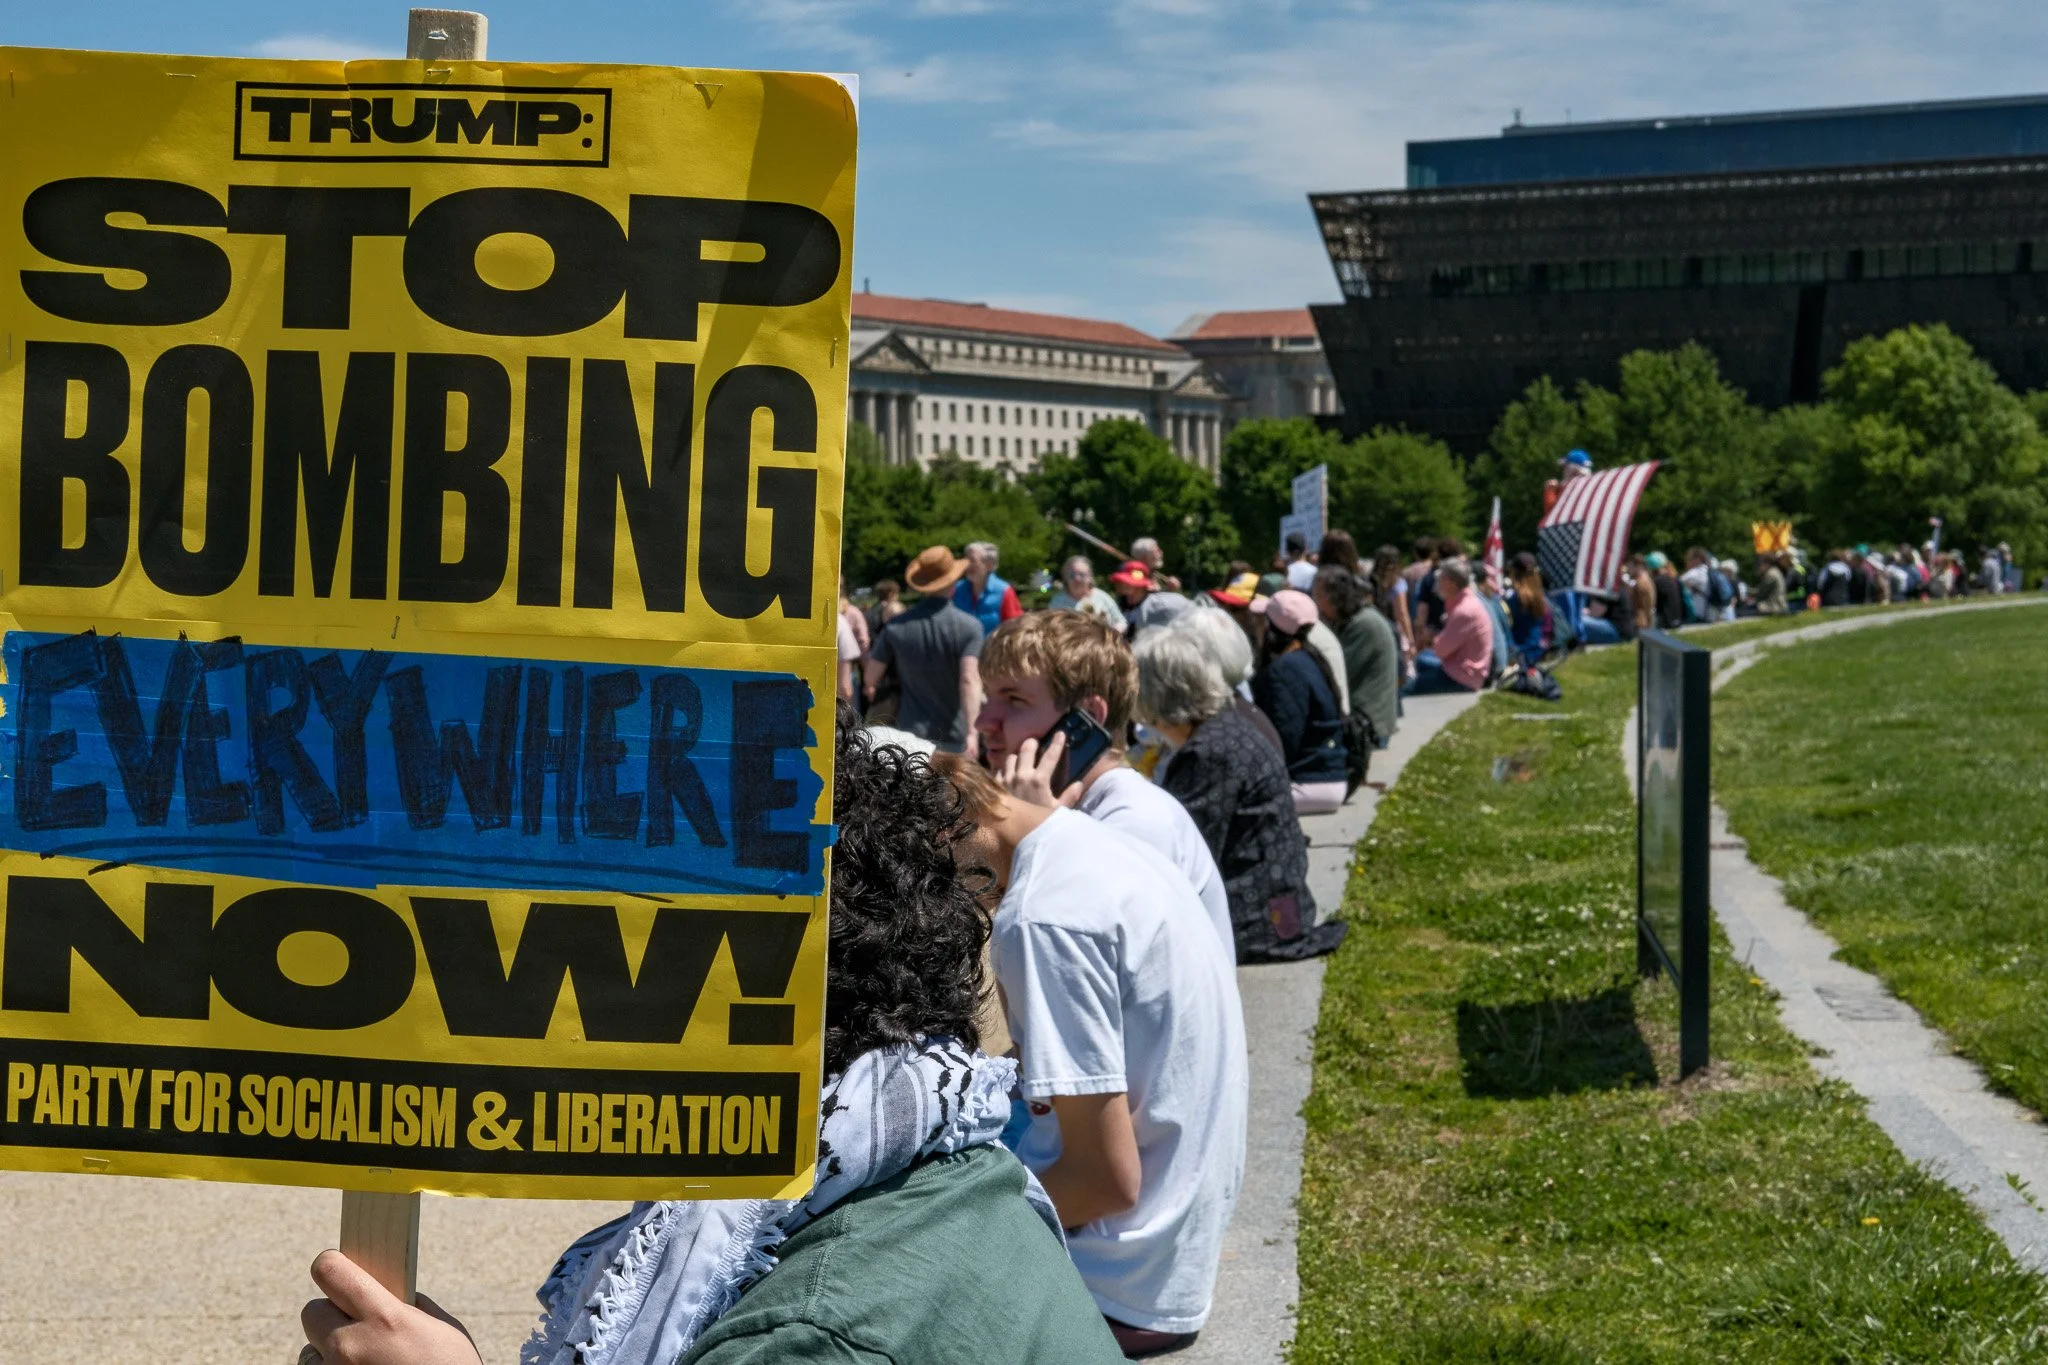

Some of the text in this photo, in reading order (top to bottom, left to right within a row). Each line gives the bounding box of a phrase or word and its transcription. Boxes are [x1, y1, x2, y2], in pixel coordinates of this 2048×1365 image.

[251, 97, 595, 149] TRUMP:
[19, 177, 842, 342] STOP
[19, 340, 818, 619] BOMBING
[14, 627, 811, 874] EVERYWHERE
[1, 874, 811, 1046] NOW!
[6, 1062, 781, 1155] PARTY FOR SOCIALISM & LIBERATION
